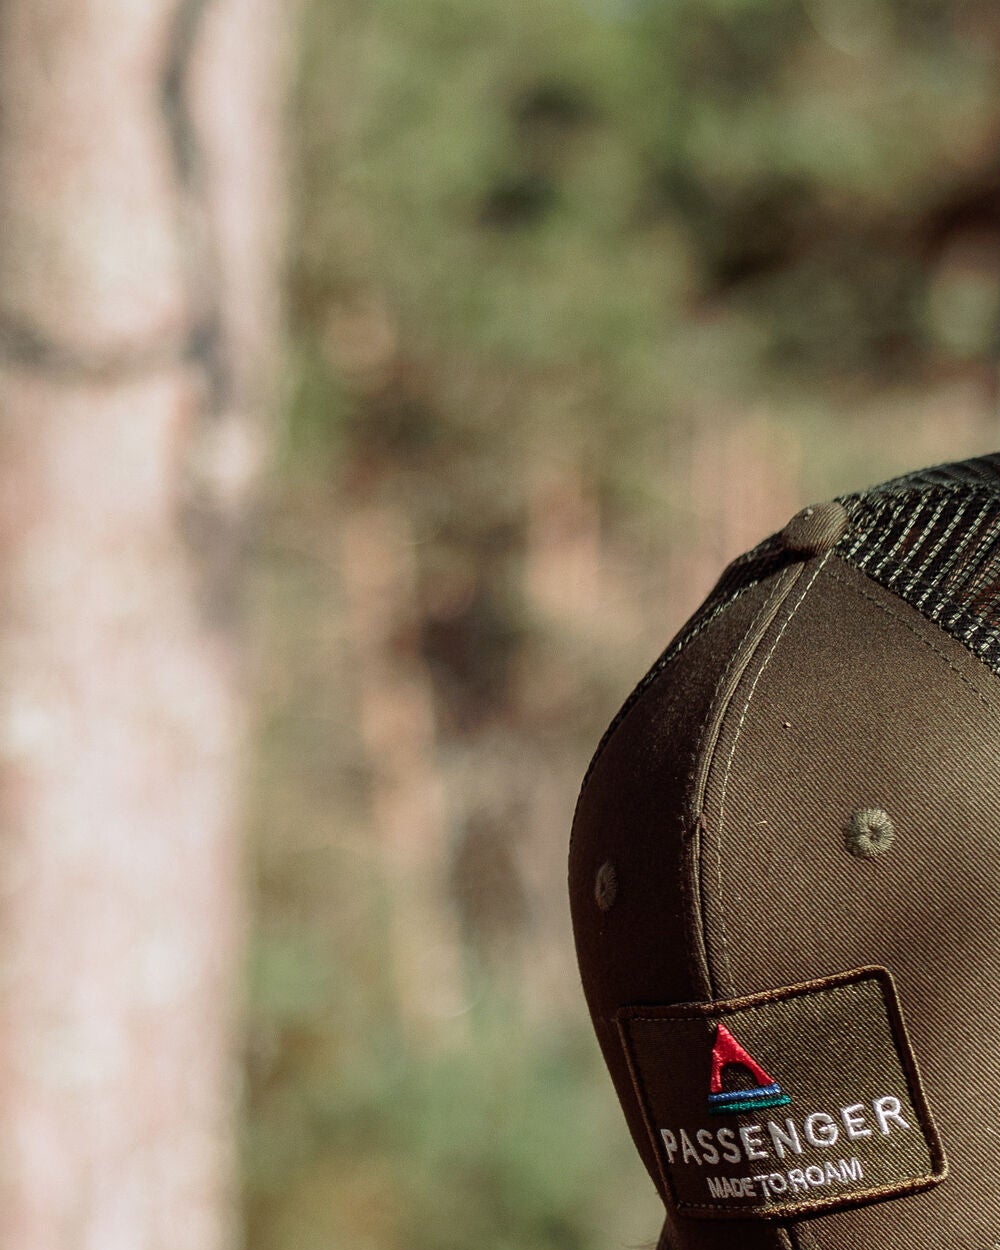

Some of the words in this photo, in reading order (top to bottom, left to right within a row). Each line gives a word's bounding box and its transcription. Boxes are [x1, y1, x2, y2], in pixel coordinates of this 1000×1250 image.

[660, 1096, 910, 1167] PASSENGER
[708, 1176, 756, 1199] MADE
[753, 1172, 788, 1198] TO
[788, 1157, 864, 1194] ROAM
